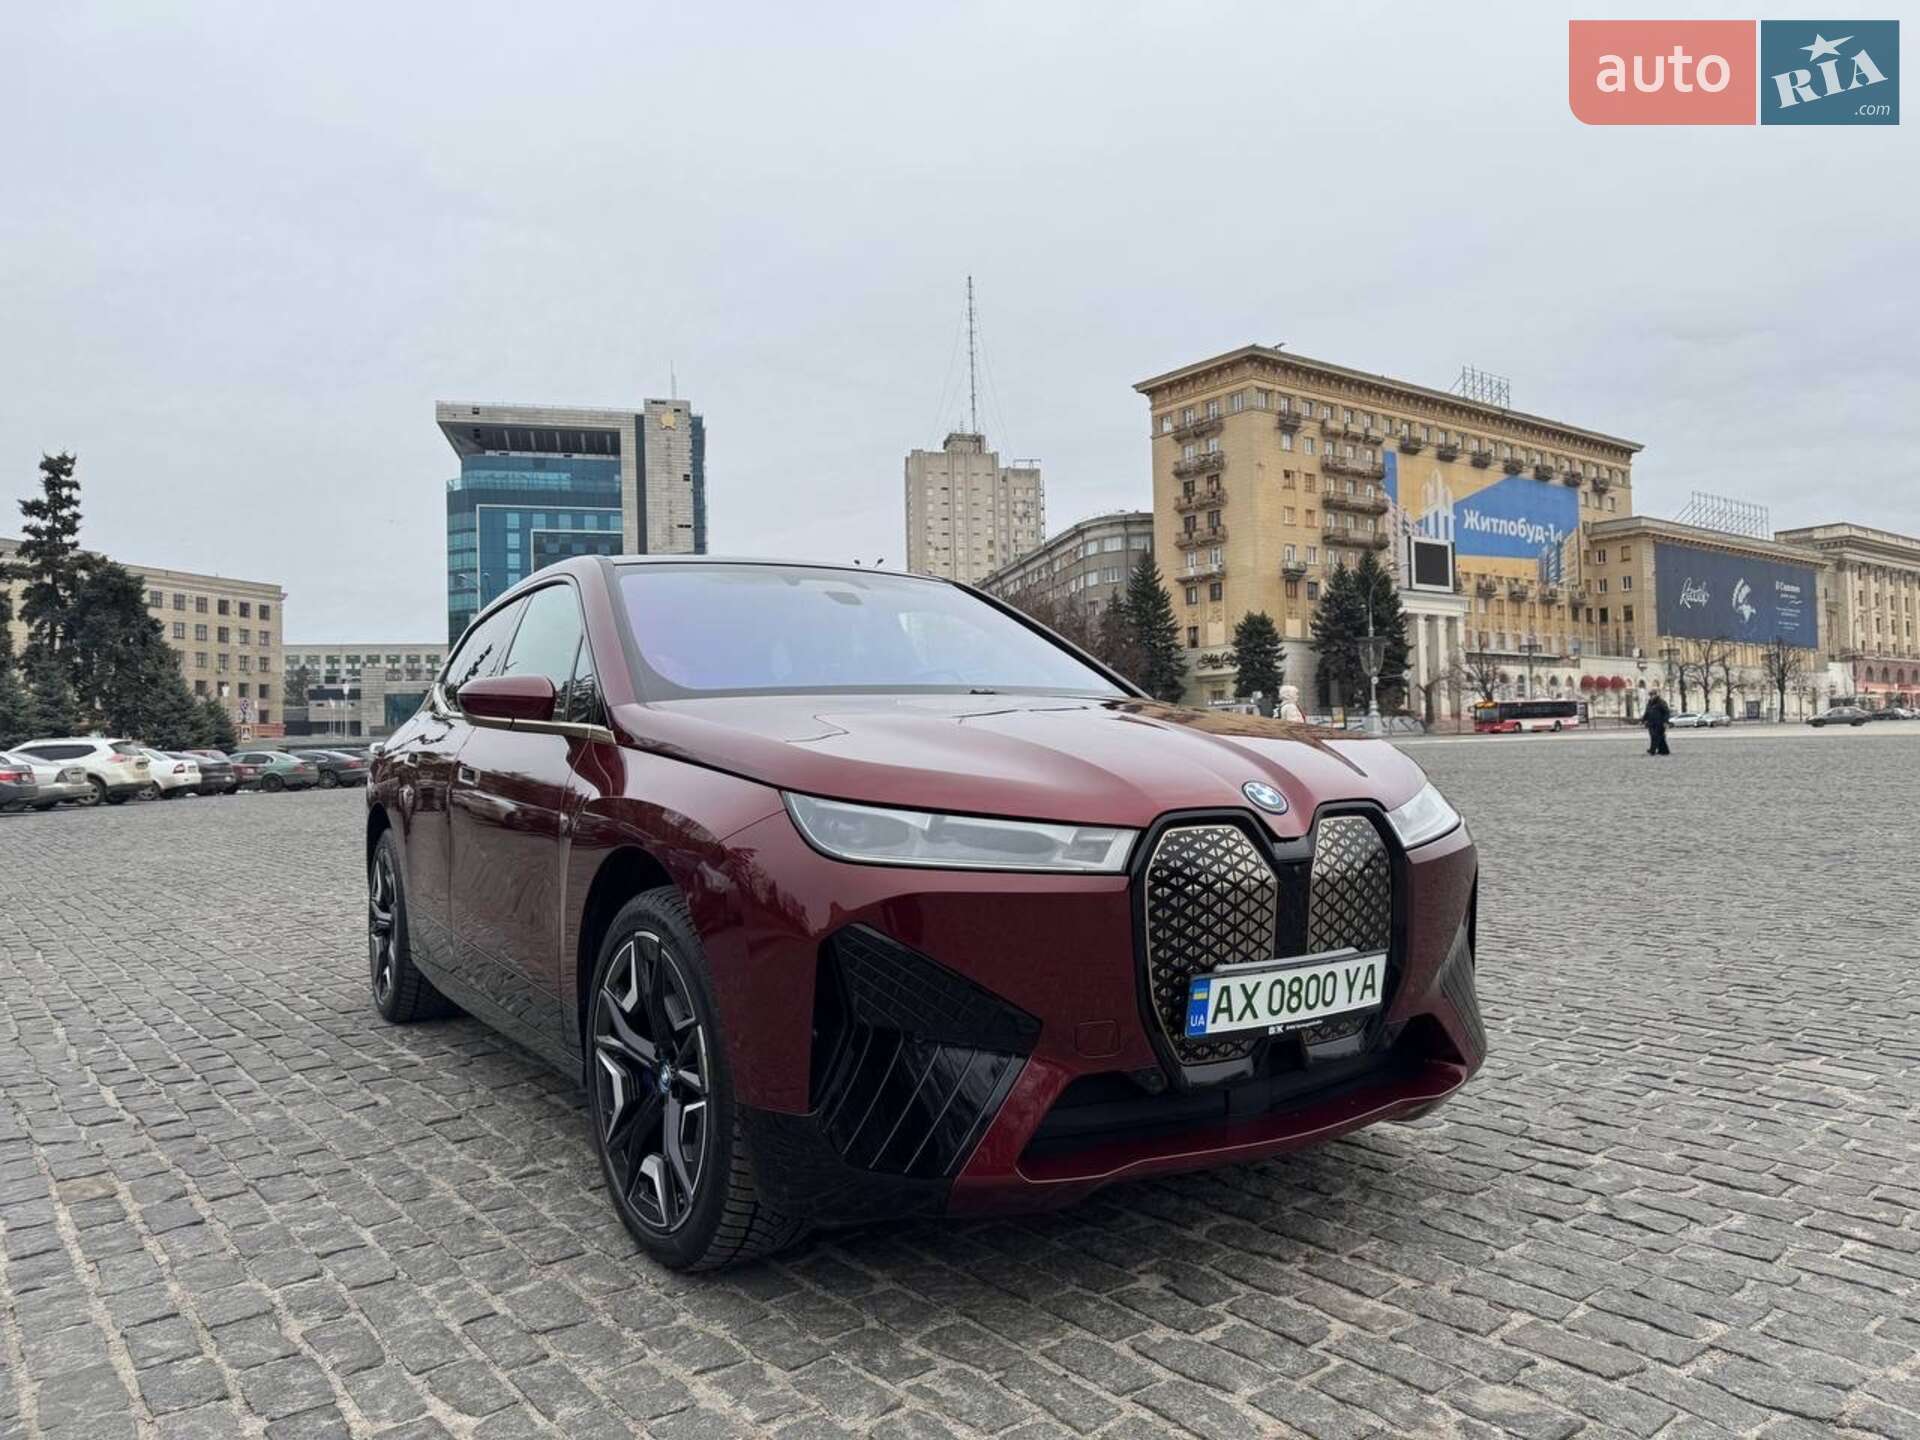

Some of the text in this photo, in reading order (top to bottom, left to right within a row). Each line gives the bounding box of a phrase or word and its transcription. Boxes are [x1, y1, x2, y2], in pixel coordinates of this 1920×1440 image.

[1211, 963, 1376, 1024] AX 0800 YA
[1190, 1014, 1205, 1027] UA
